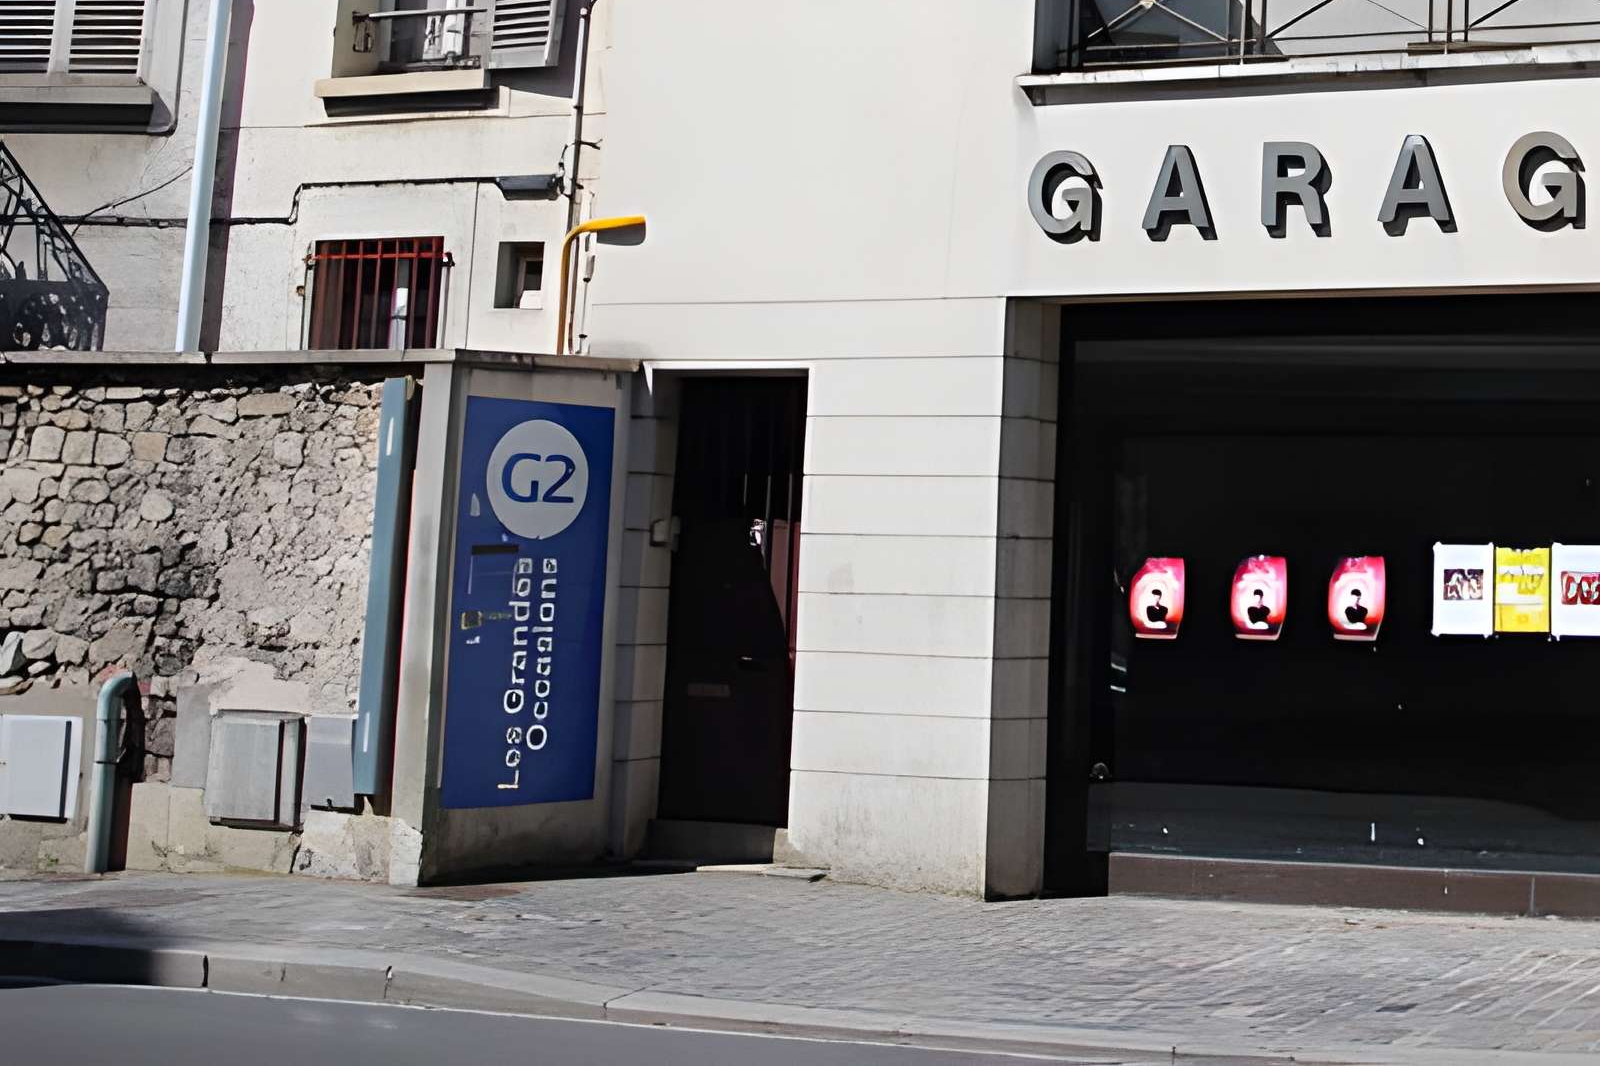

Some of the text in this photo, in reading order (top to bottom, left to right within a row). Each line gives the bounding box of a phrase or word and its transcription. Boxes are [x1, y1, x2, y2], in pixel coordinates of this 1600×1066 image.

[501, 453, 576, 504] G2
[526, 557, 557, 750] Occasions
[498, 726, 522, 790] Les
